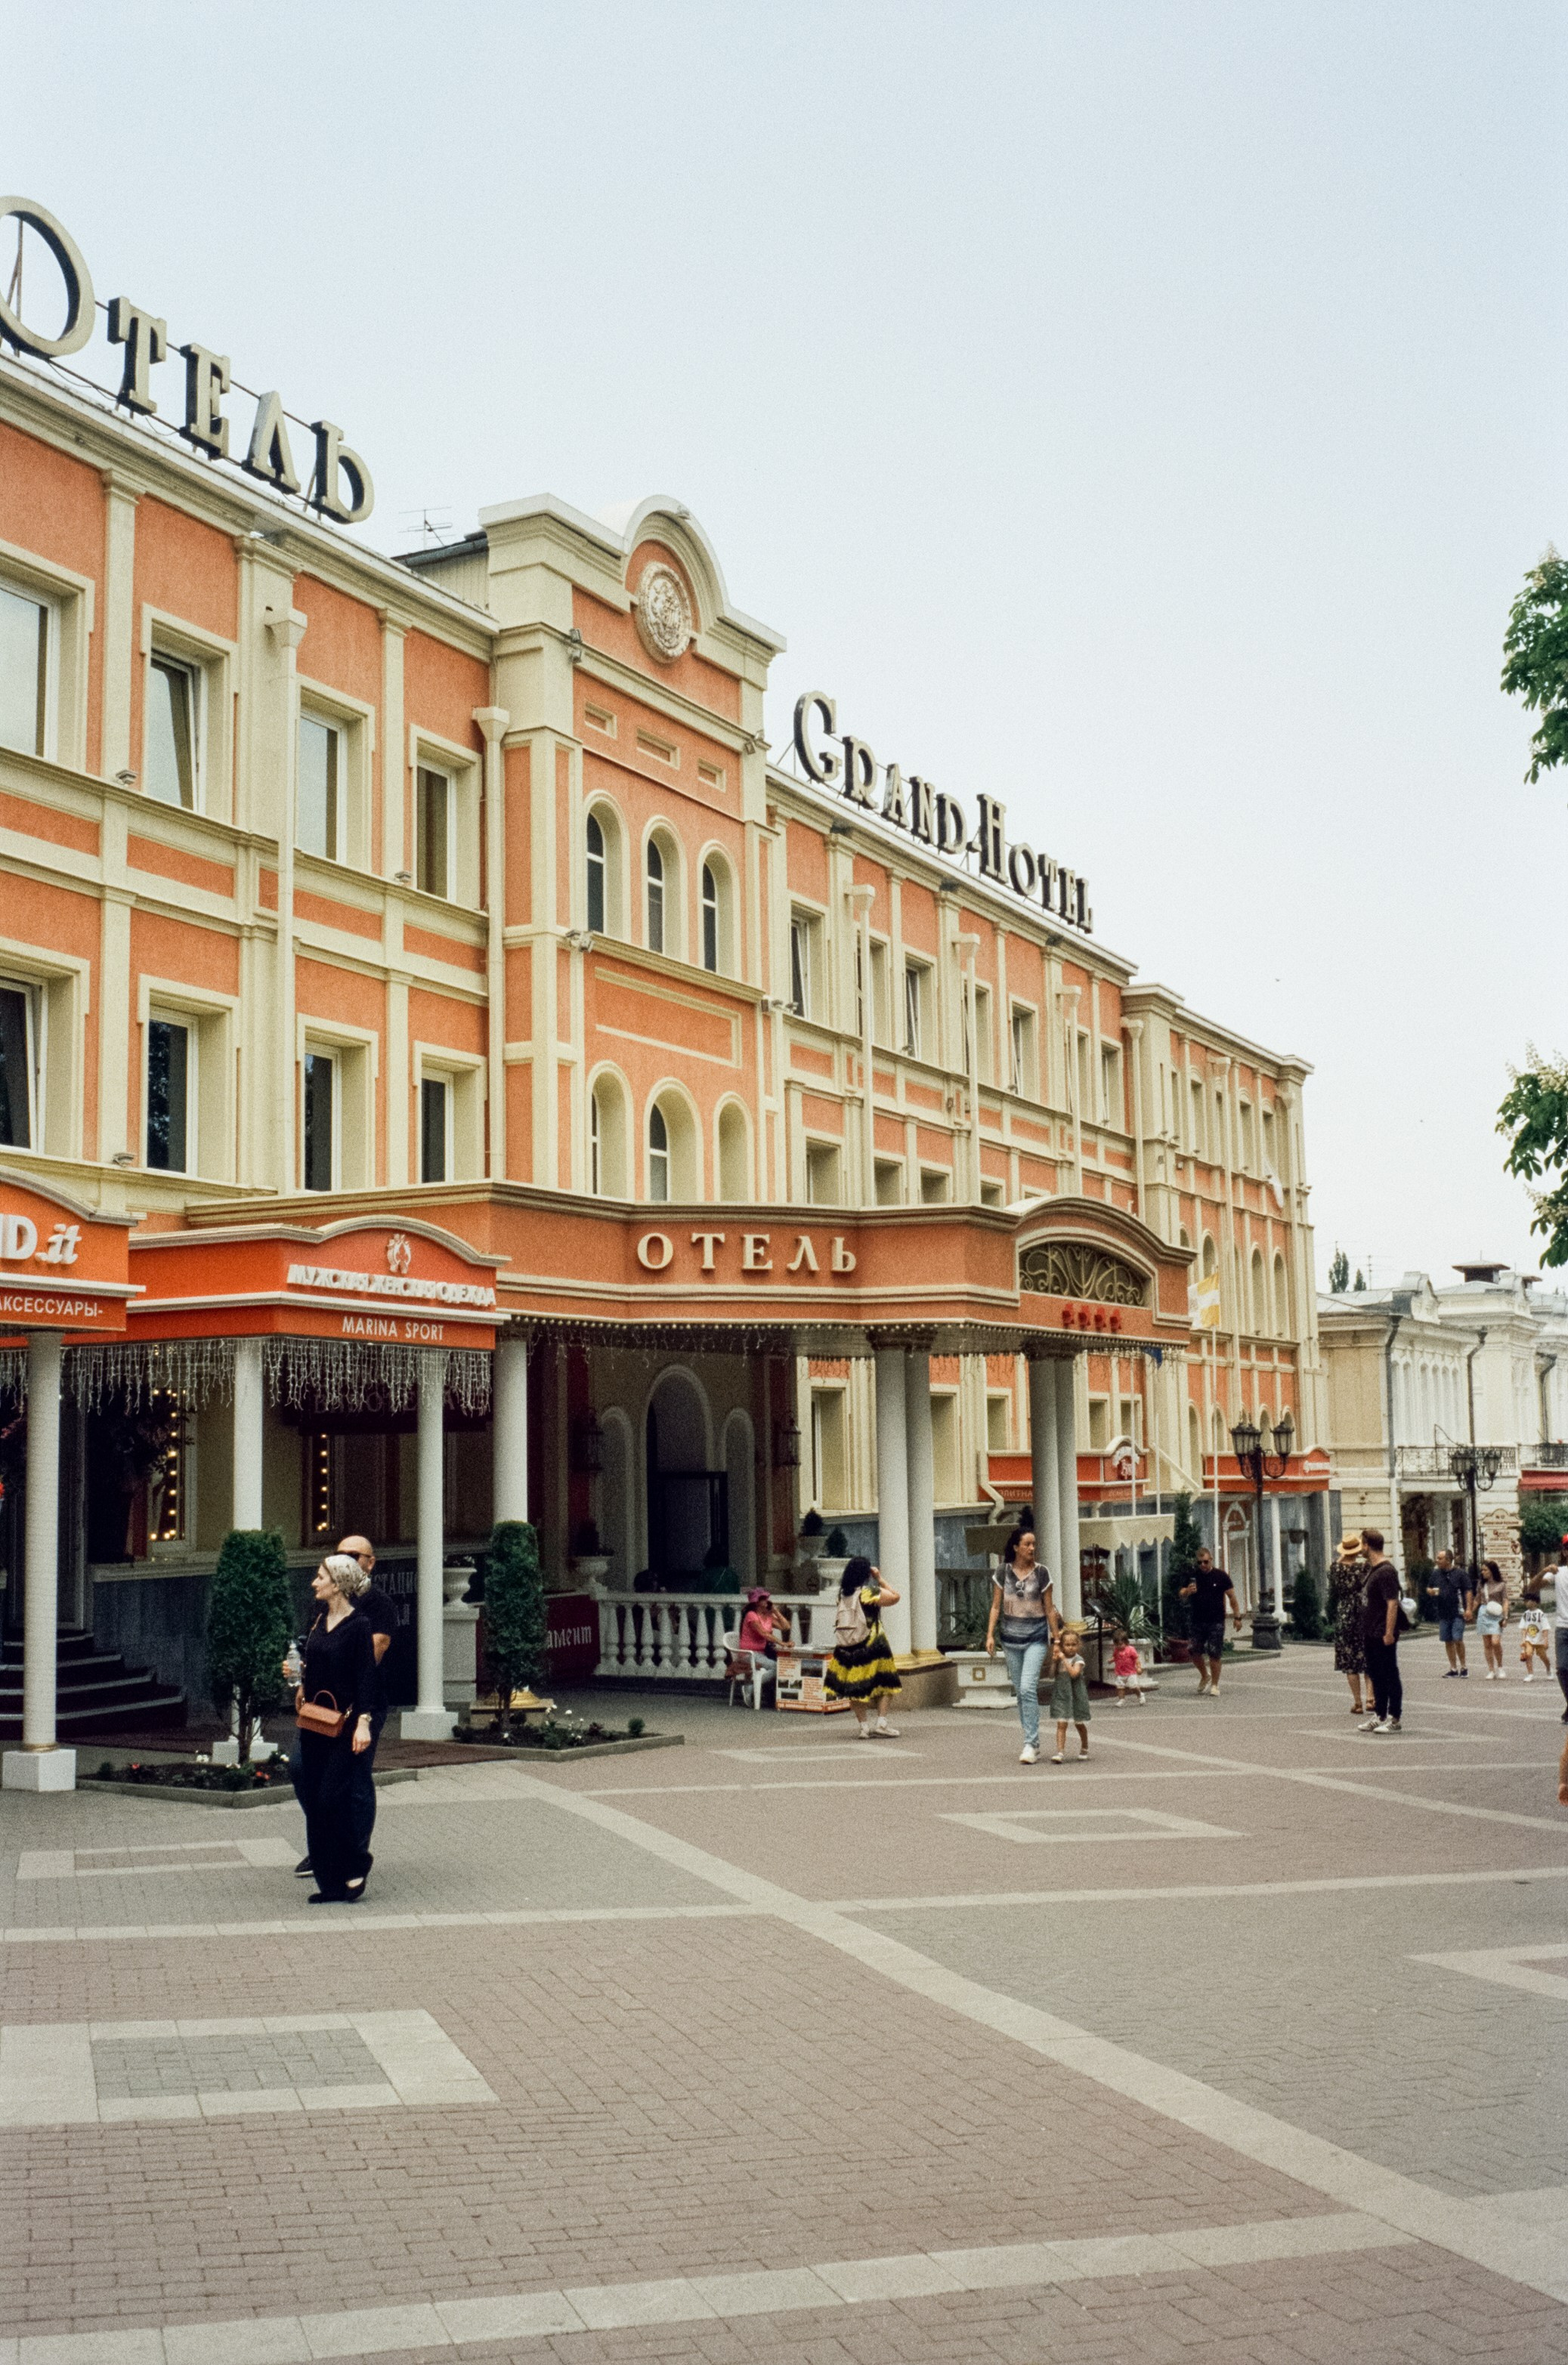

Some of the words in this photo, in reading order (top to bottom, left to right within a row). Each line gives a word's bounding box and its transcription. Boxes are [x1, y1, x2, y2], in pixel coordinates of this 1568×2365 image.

[0, 196, 375, 524] ОТЕЛЬ
[637, 1232, 858, 1272] ОТЕЛЬ
[0, 1295, 104, 1316] КСЕССУАРЫ-
[342, 1316, 397, 1337] MARINA
[405, 1324, 444, 1341] SPORT
